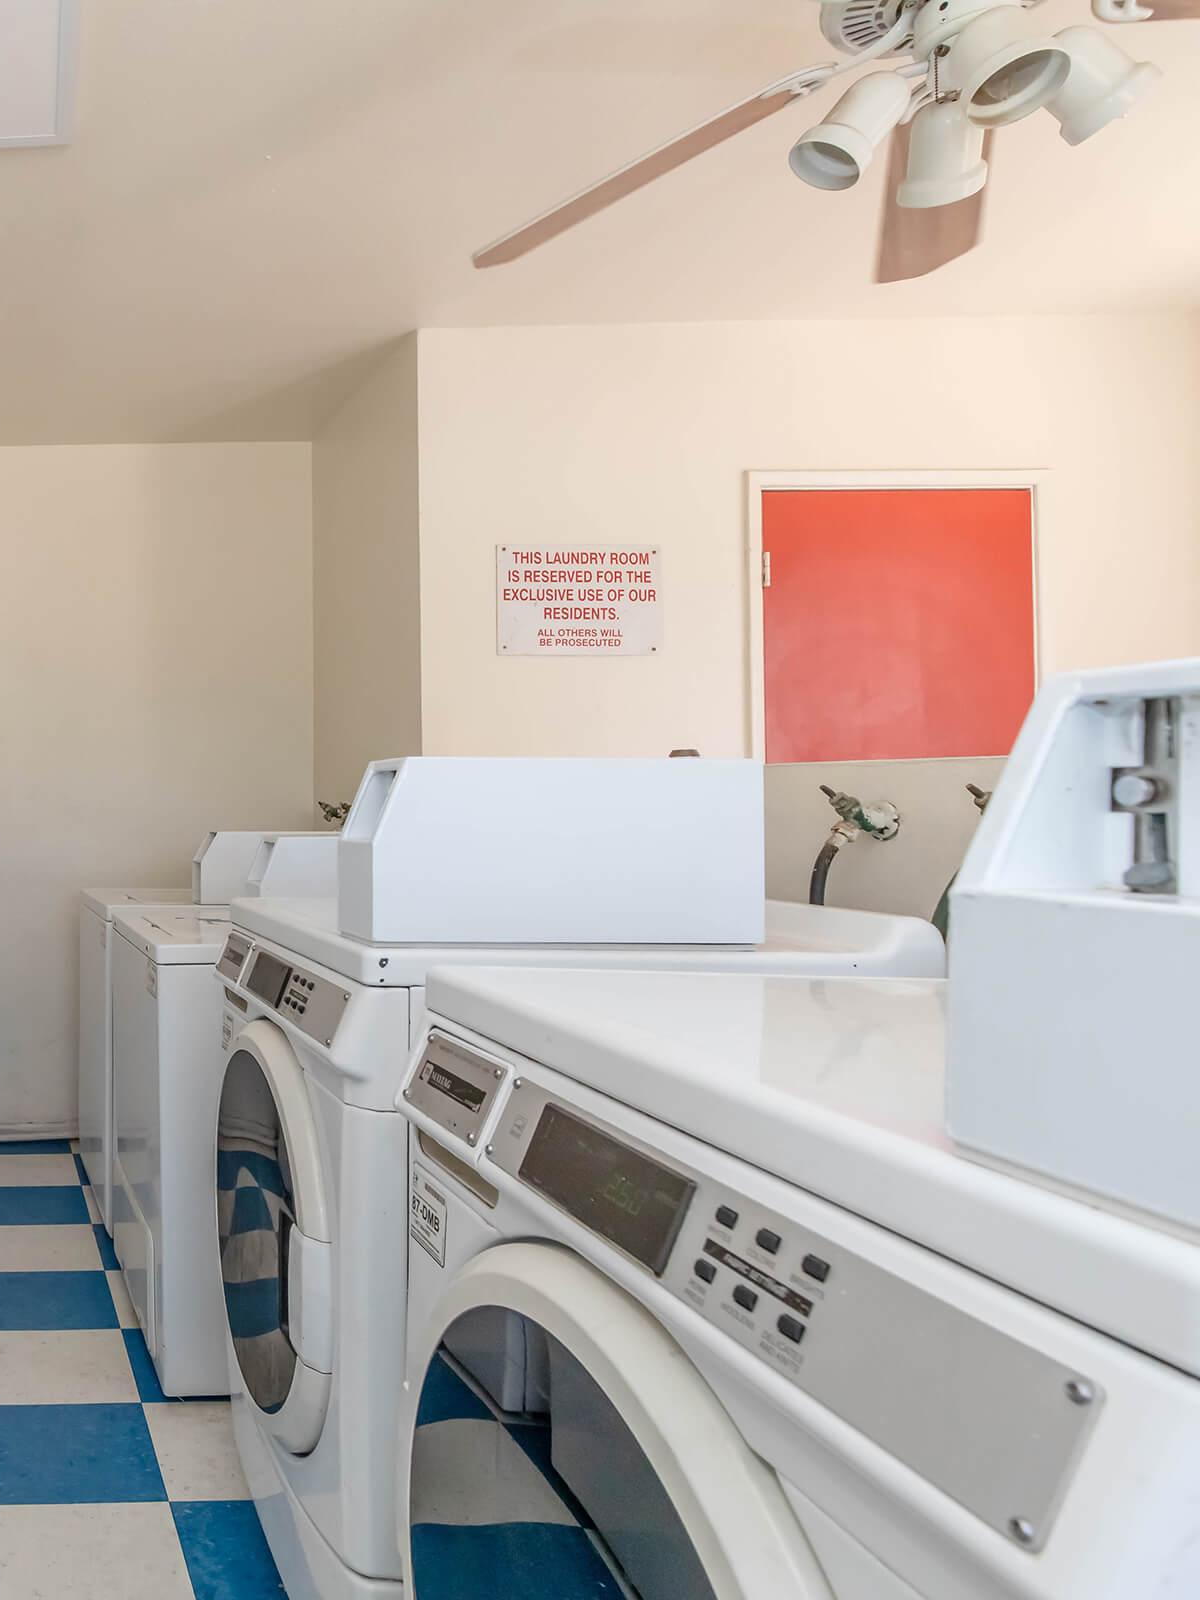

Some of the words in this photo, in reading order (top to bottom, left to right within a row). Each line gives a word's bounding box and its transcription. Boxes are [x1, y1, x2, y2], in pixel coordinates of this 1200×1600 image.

[512, 551, 542, 564] THIS
[546, 552, 606, 565] LAUNDRY
[610, 552, 650, 565] ROOM
[508, 570, 520, 583] IS
[524, 570, 592, 583] RESERVED
[597, 570, 623, 583] FOR
[626, 571, 652, 583] THE
[503, 588, 574, 601] EXCLUSIVE
[578, 589, 603, 601] USE
[607, 589, 625, 601] OF
[628, 589, 657, 602] OUR
[543, 607, 620, 620] RESIDENTS.
[537, 629, 555, 637] ALL
[558, 629, 597, 637] OTHERS
[600, 629, 623, 637] WILL
[539, 638, 552, 647] BE
[555, 638, 621, 647] PROSECUTED
